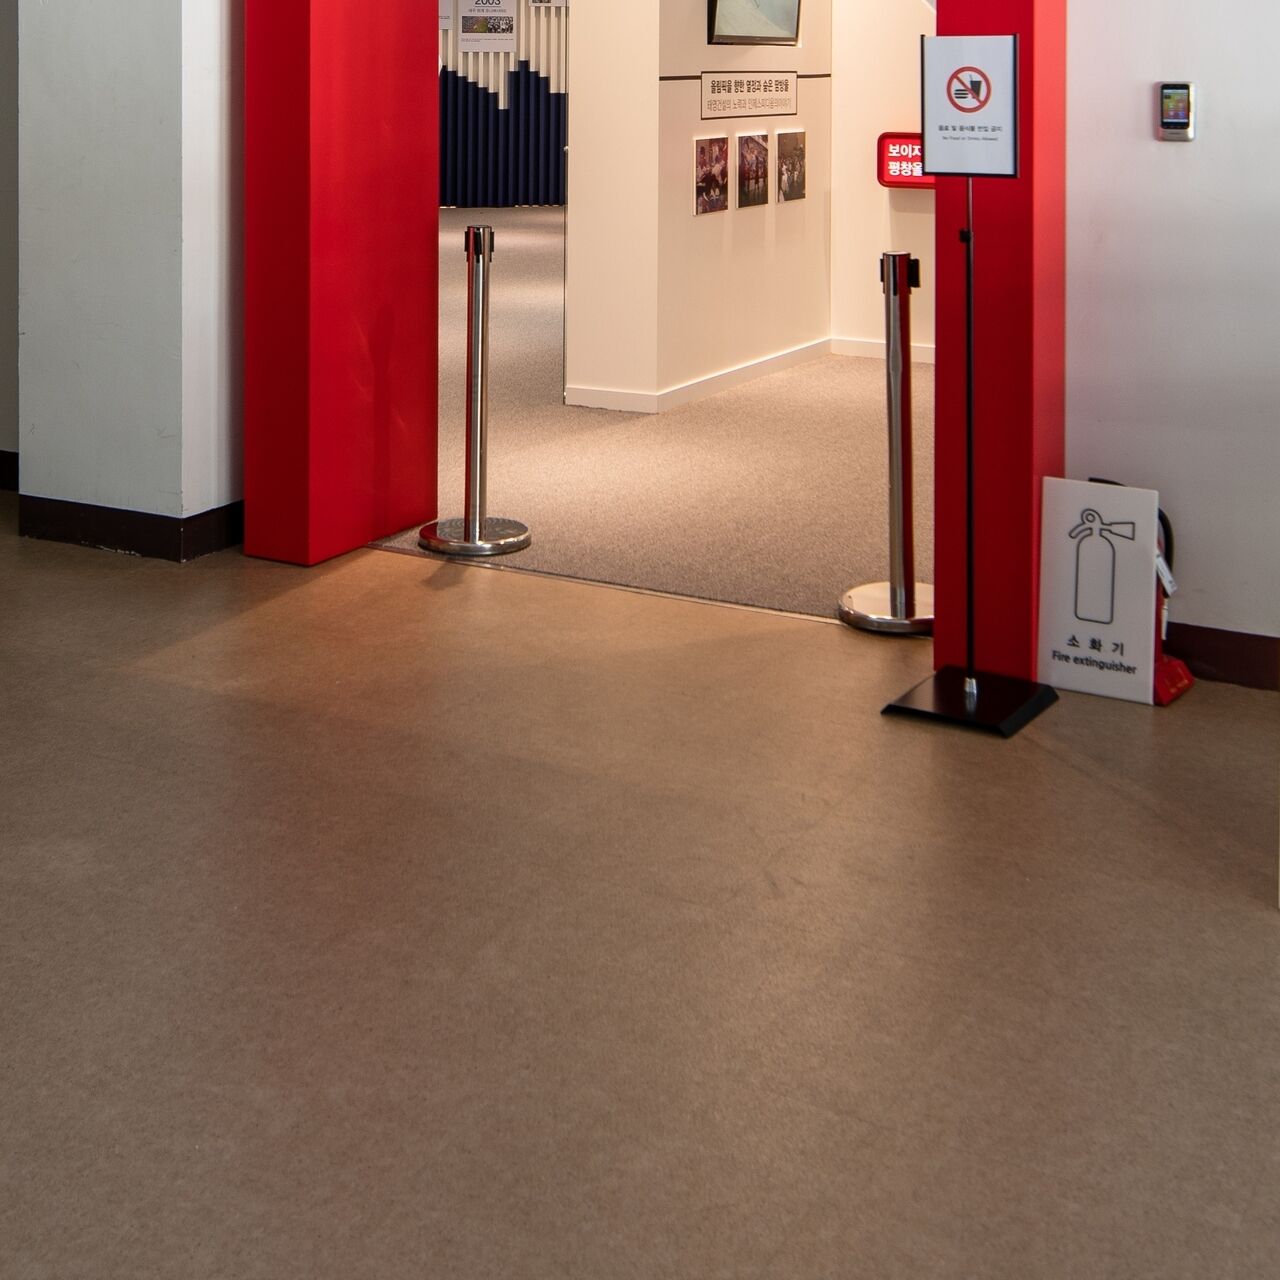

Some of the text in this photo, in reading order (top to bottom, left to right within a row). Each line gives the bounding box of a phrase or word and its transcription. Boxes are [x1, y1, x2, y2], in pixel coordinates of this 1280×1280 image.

[710, 80, 732, 94] 올림픽을
[1052, 650, 1138, 675] Fire extinguisher
